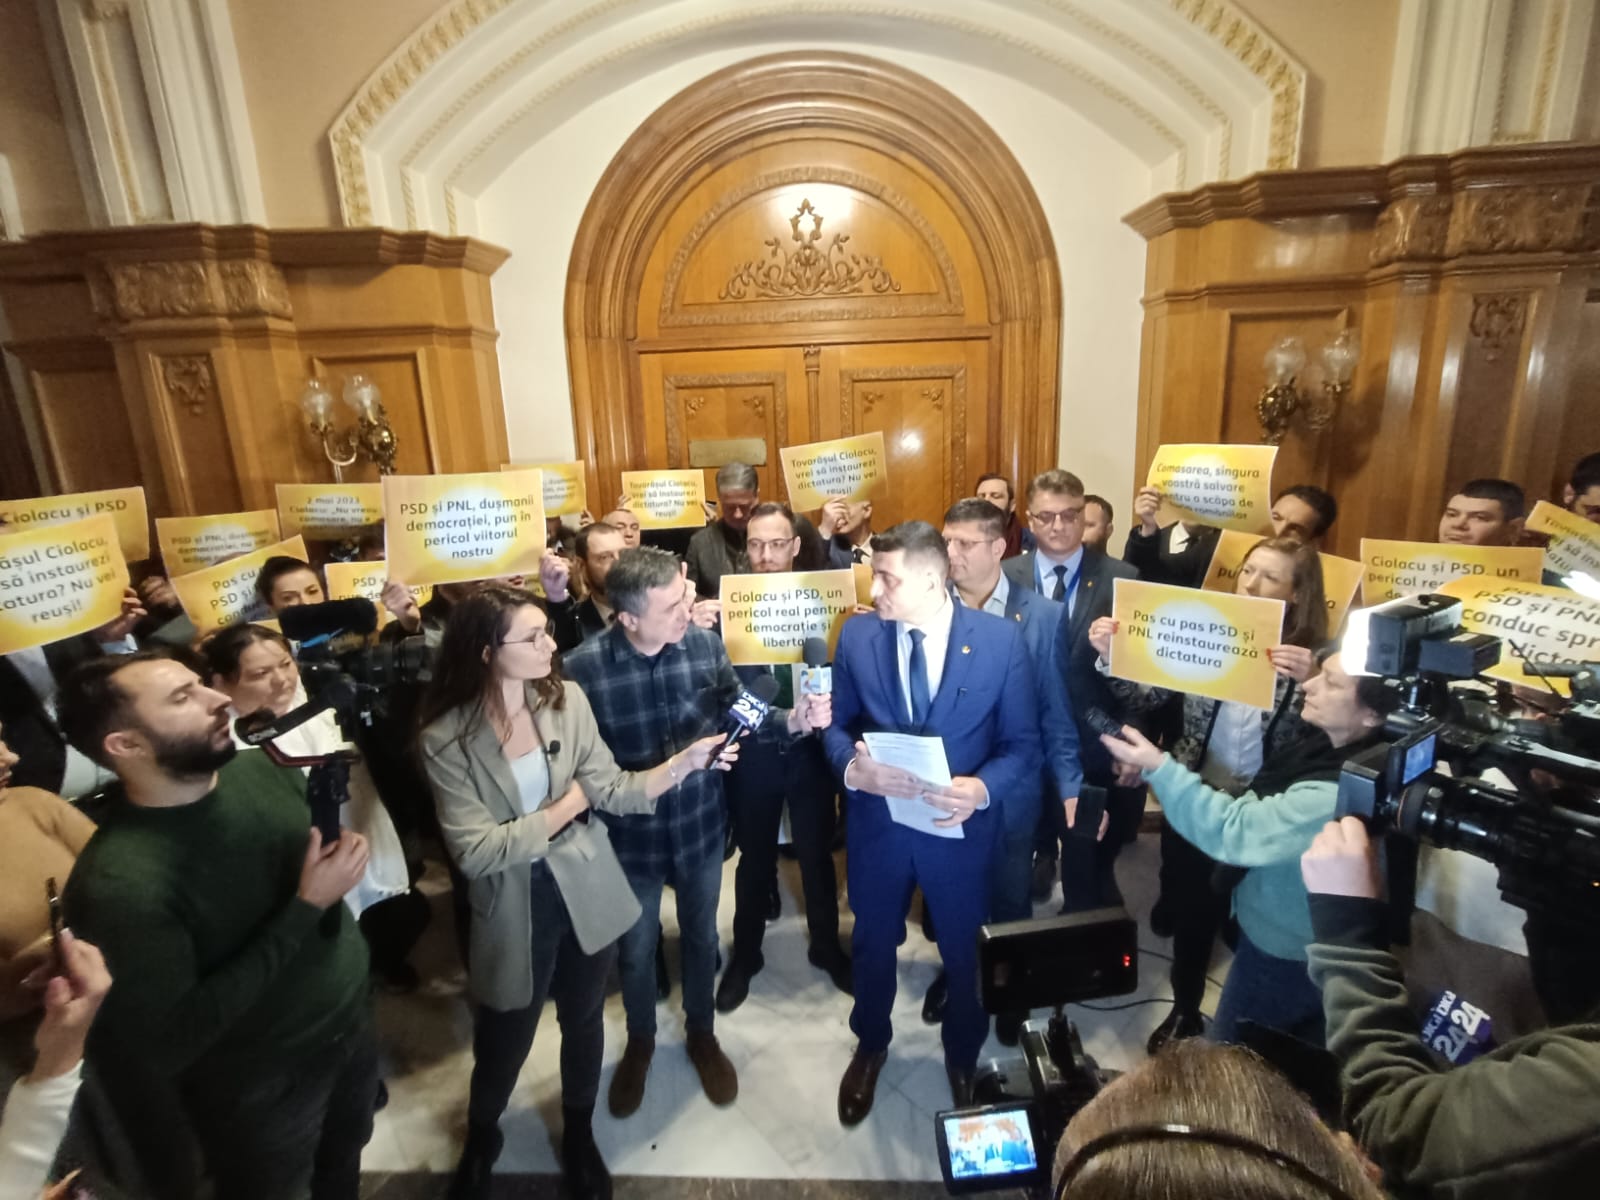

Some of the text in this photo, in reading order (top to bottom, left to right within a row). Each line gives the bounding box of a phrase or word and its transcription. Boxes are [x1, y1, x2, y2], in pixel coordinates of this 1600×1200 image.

[848, 474, 861, 482] Nu
[1216, 464, 1260, 480] singura
[1204, 481, 1245, 492] salvare
[95, 500, 128, 513] PSD
[400, 503, 428, 516] PSD
[432, 503, 442, 516] și
[446, 500, 476, 512] PNL,
[479, 495, 534, 511] dușmanii
[1238, 498, 1254, 508] de
[406, 510, 532, 532] democrației, pun în
[46, 537, 109, 560] Ciolacu,
[423, 528, 518, 549] pericol viitorul
[452, 546, 494, 560] nostru
[28, 551, 111, 584] instaurezi
[1370, 556, 1426, 572] Ciolacu
[1432, 560, 1444, 575] și
[1496, 567, 1520, 578] un
[0, 568, 117, 611] atura? Nu vei
[212, 570, 256, 592] Pas cu
[352, 577, 376, 588] PSD
[1368, 573, 1417, 587] pericol
[210, 592, 238, 611] PSD
[730, 588, 842, 604] Ciolacu și PSD, un
[1474, 590, 1522, 607] PSD
[1526, 602, 1552, 616] și
[32, 599, 82, 624] reuși!
[728, 604, 847, 621] pericol real pentru
[745, 621, 818, 634] democrație
[1133, 610, 1255, 644] Pas cu pas PSD și
[1461, 608, 1600, 649] conduc spr
[763, 636, 805, 648] liberta
[1128, 624, 1258, 659] PNL reinstaurează
[1156, 646, 1222, 668] dictatura
[732, 698, 761, 728] 24
[1450, 1000, 1490, 1036] 24
[1433, 1025, 1479, 1062] 24
